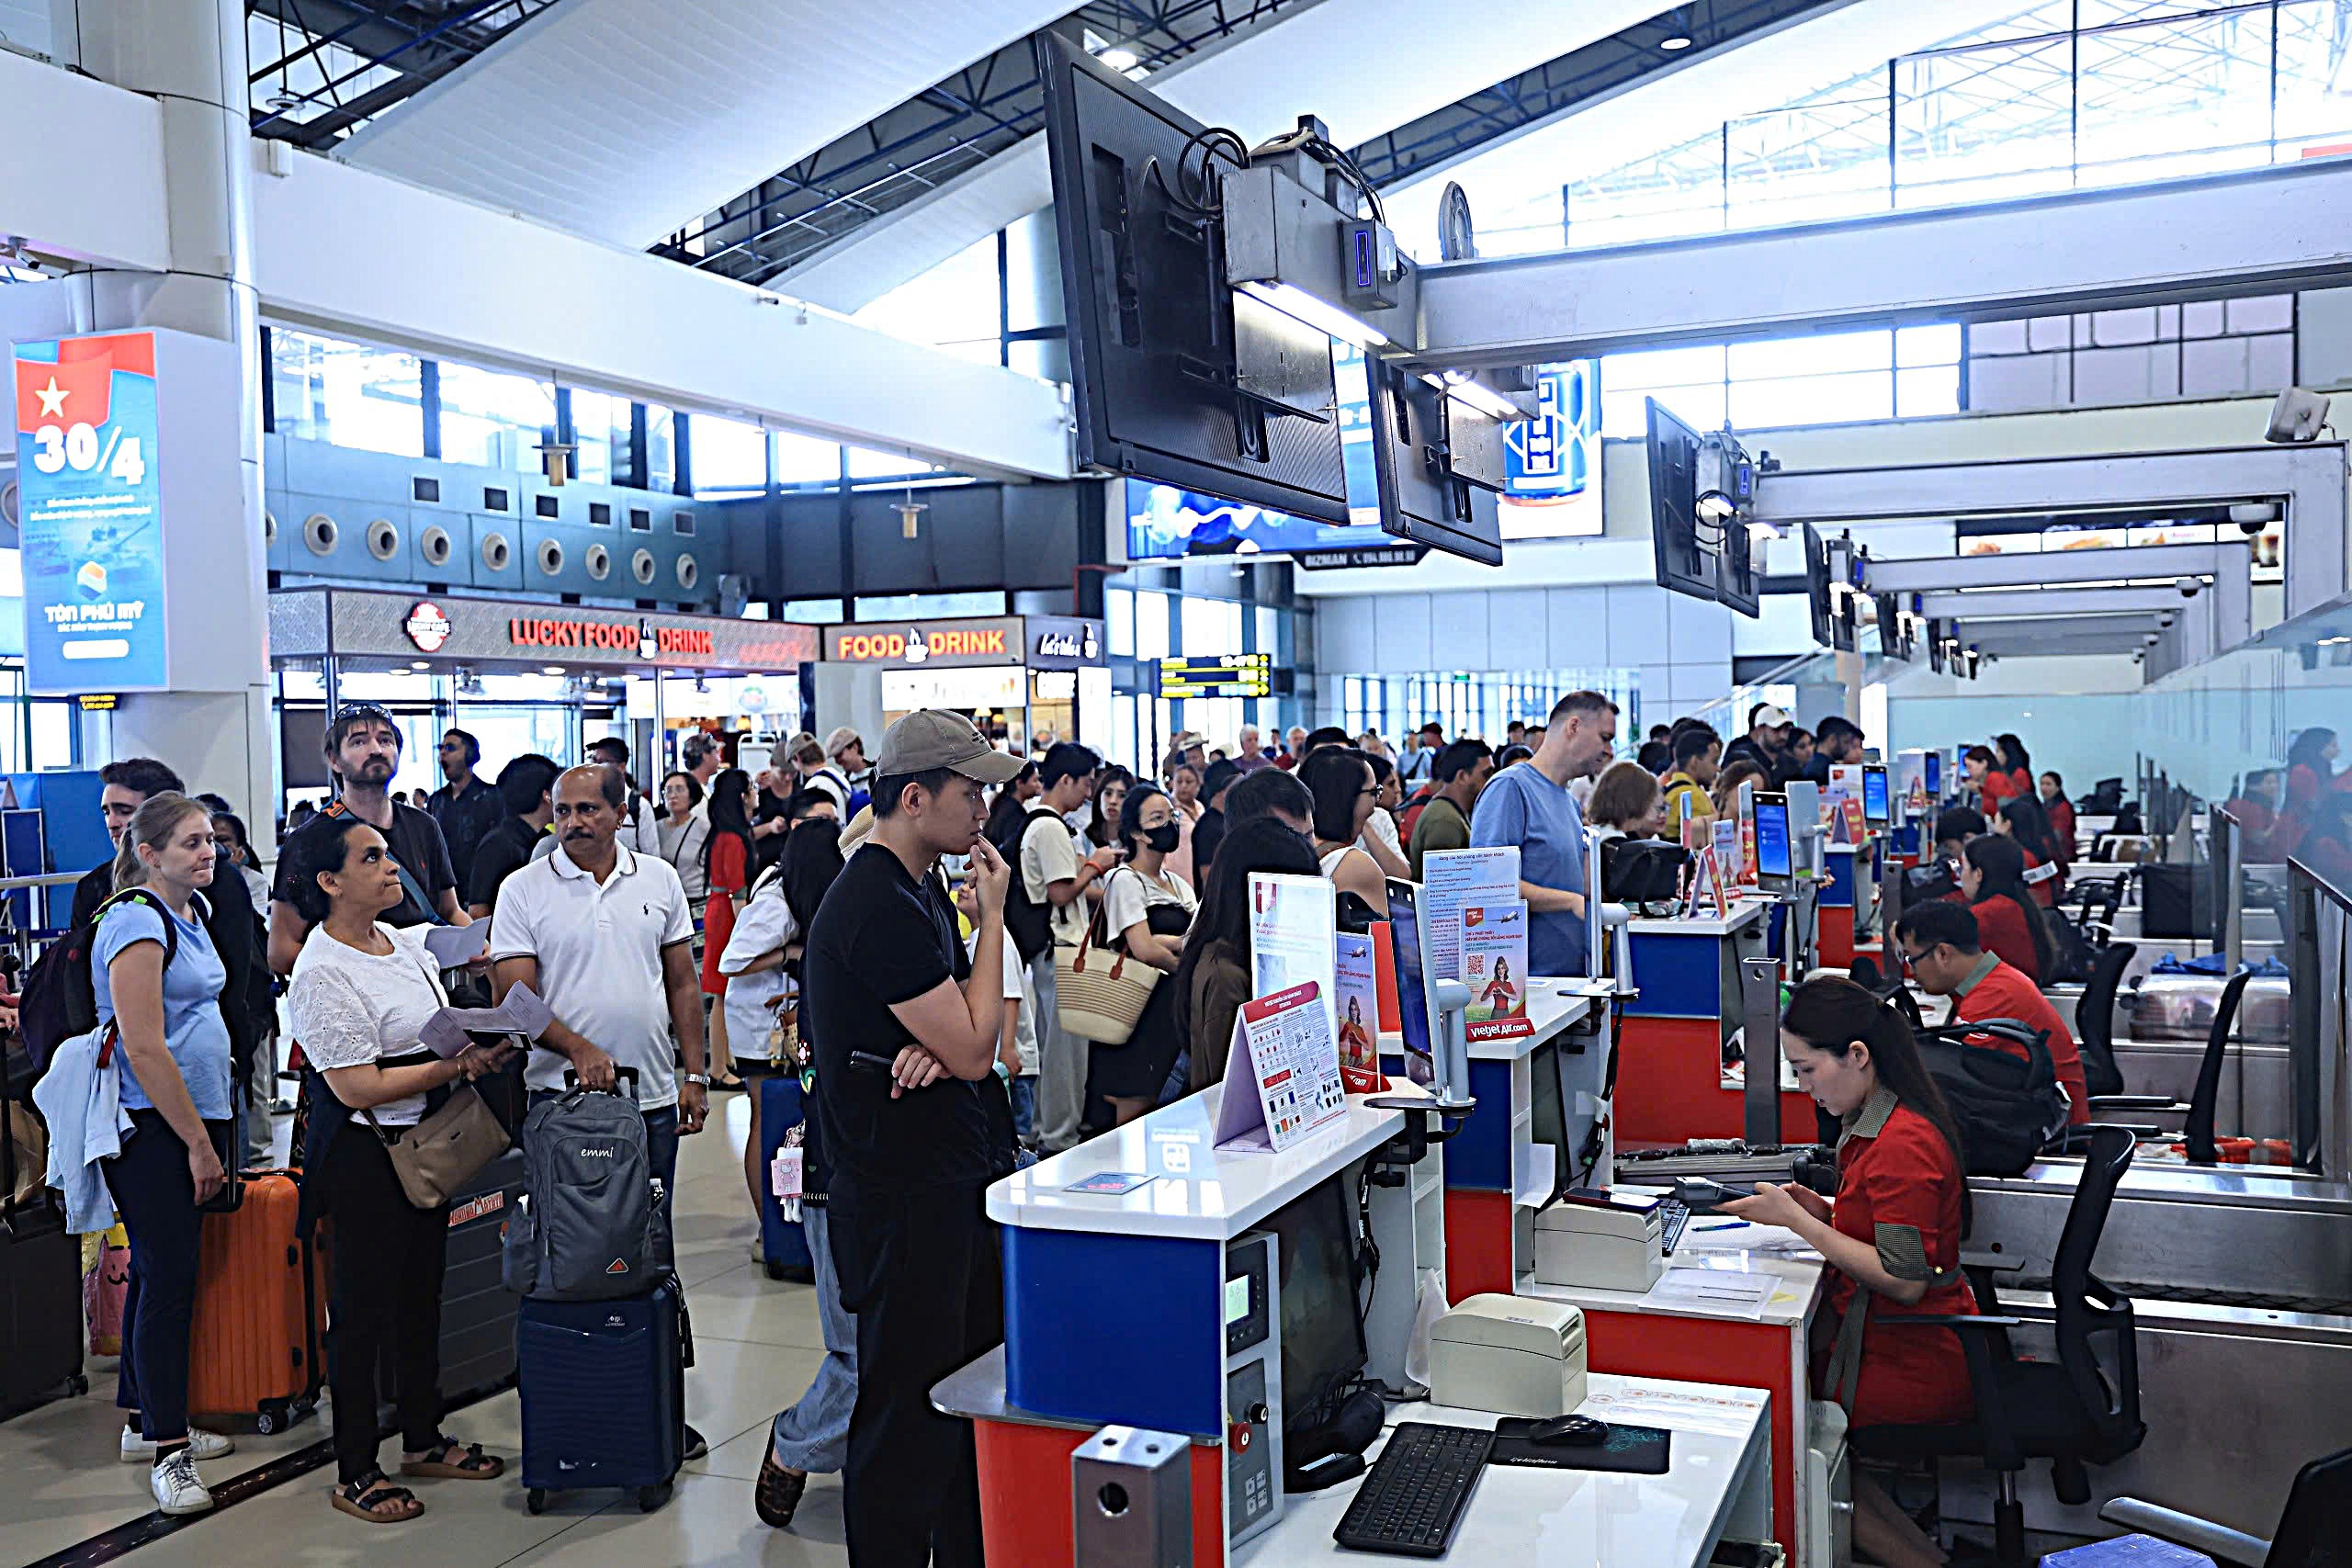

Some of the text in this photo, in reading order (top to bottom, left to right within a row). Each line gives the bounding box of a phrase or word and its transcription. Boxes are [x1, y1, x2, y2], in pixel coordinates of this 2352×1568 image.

[34, 423, 145, 485] 30/4
[80, 602, 115, 621] PHÚ
[511, 618, 582, 647] LUCKY
[583, 623, 639, 650] FOOD
[657, 627, 715, 654] DRINK
[838, 630, 1006, 660] FOOD DRINK
[581, 1146, 614, 1157] emmi
